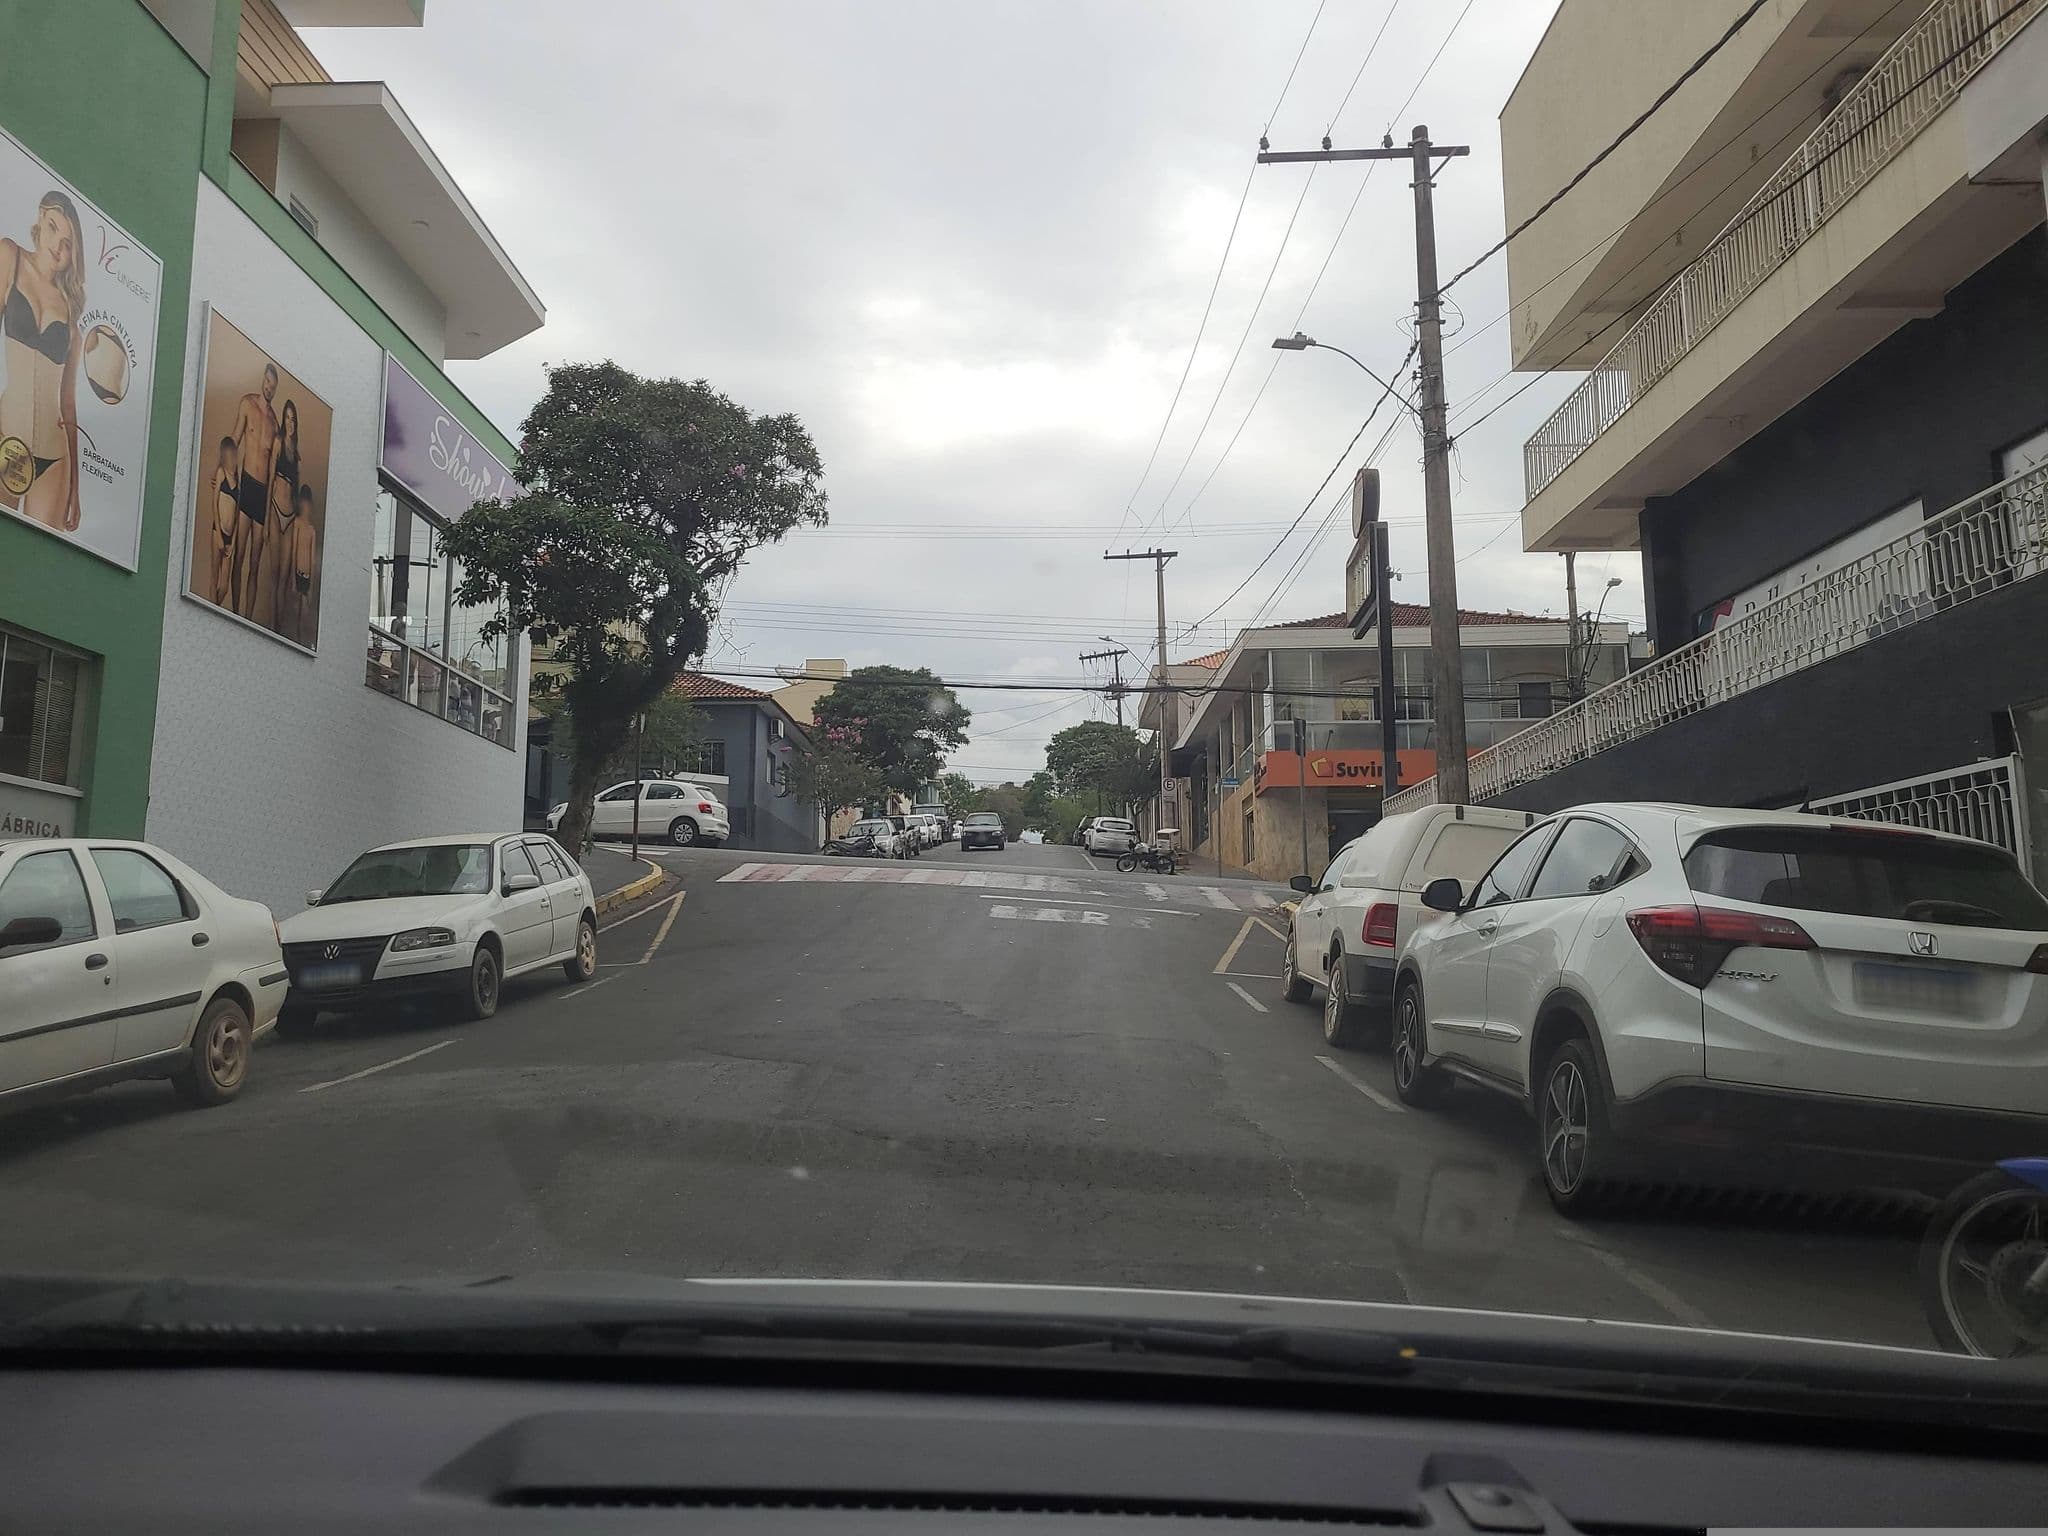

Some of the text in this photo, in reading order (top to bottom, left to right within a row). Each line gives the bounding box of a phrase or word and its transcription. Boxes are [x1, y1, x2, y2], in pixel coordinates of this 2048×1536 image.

[110, 315, 137, 369] CINTURA
[83, 447, 126, 477] BARBATANAS
[1716, 968, 1779, 982] HR-V
